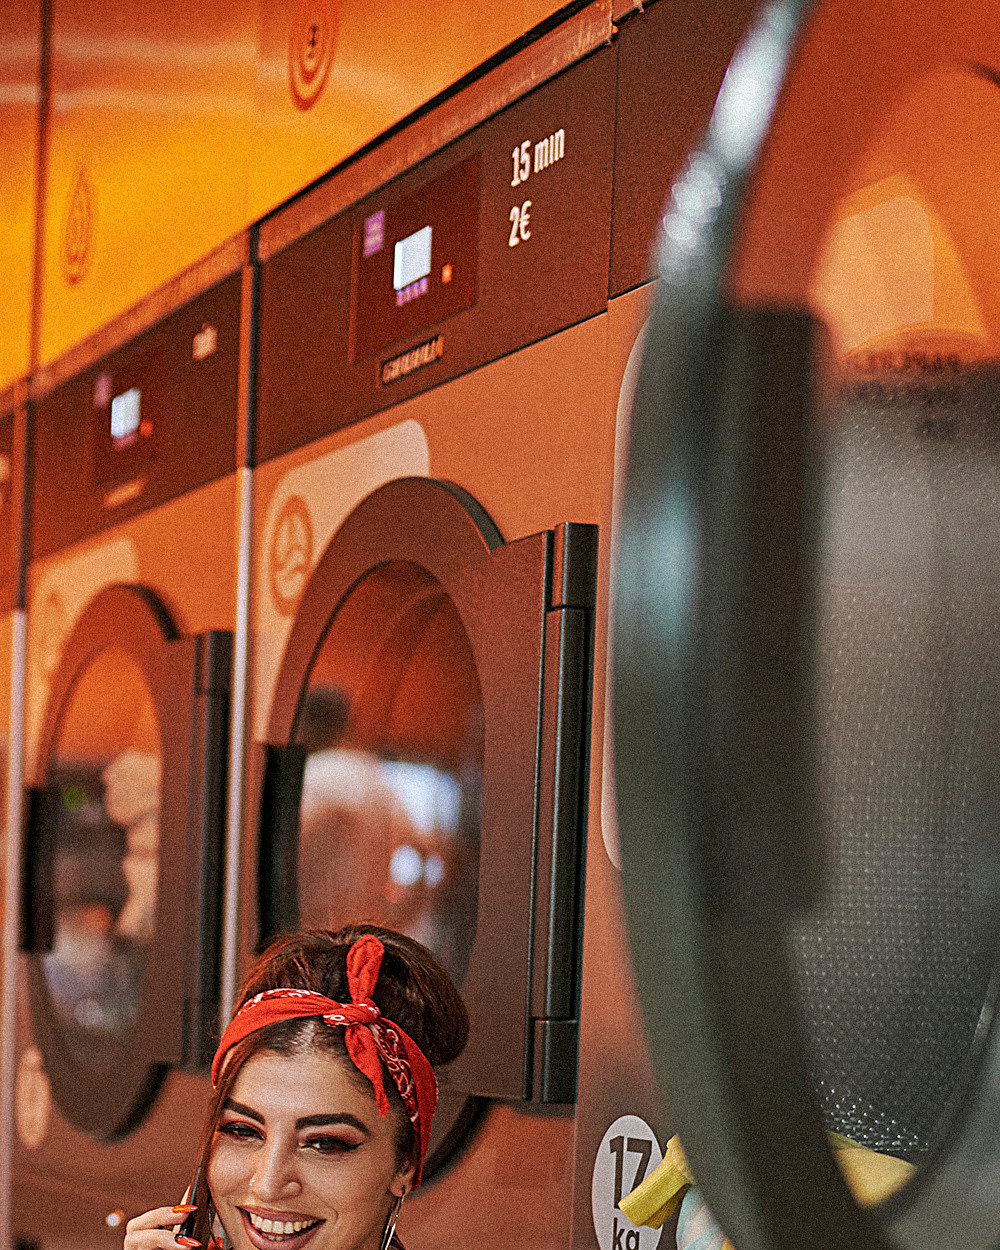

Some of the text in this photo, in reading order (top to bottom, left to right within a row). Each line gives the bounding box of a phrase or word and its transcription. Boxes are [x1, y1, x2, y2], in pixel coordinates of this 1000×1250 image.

[511, 128, 565, 187] 15 min
[509, 200, 532, 247] 2€
[609, 1135, 653, 1210] 17
